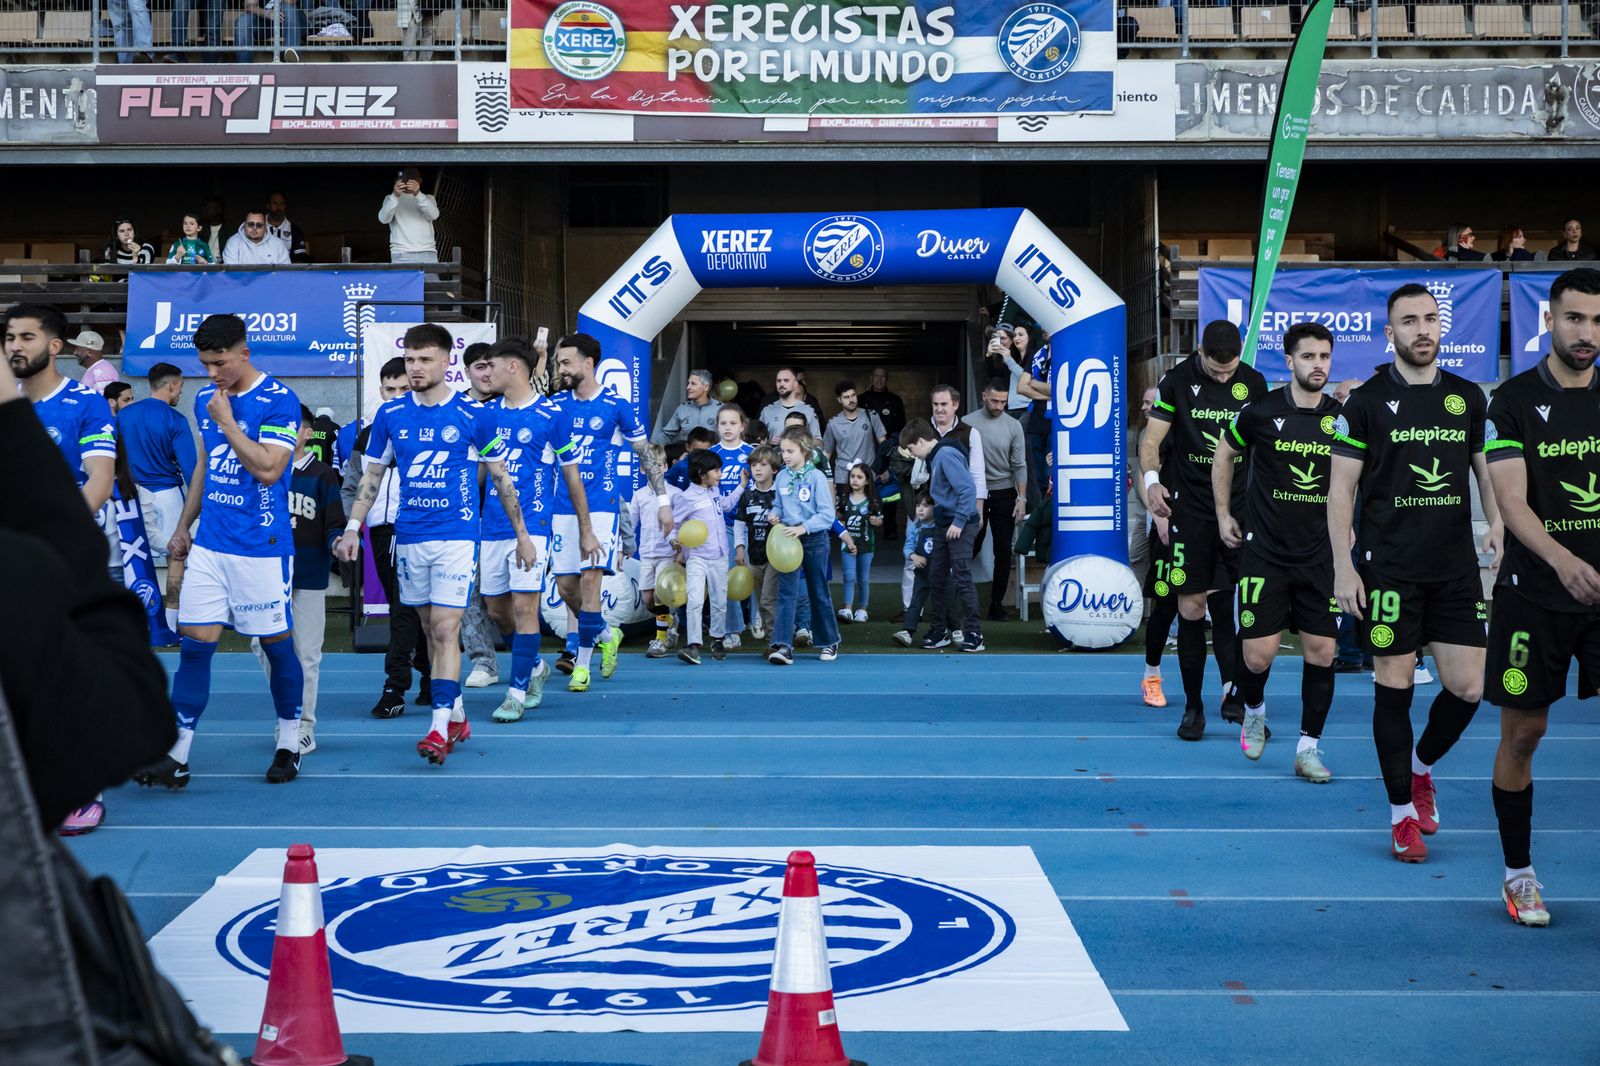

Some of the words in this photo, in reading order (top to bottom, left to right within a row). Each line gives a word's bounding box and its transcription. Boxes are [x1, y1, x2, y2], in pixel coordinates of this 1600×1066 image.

[668, 4, 954, 46] XERECISTAS
[558, 33, 613, 47] XEREZ
[668, 49, 748, 82] POR
[760, 49, 801, 83] EL
[810, 50, 955, 83] MUNDO
[1010, 60, 1069, 80] DEPORTIVO
[120, 87, 248, 117] PLAY
[542, 83, 579, 101] En
[627, 89, 728, 107] distancia
[740, 91, 801, 105] unidos
[809, 96, 859, 113] por
[1359, 84, 1399, 116] DE
[282, 120, 335, 129] EXPLORA,
[340, 120, 395, 129] DISFRUTA,
[400, 120, 448, 128] COMPITE.
[820, 119, 873, 128] EXPLORA,
[879, 119, 934, 128] DISFRUTA,
[939, 119, 988, 127] COMPITE.
[701, 229, 772, 253] XEREZ
[916, 229, 990, 258] Diver
[707, 253, 767, 270] DEPORTIVO
[329, 352, 345, 361] de
[1436, 358, 1463, 367] erez
[1390, 426, 1466, 446] telepizza
[1275, 439, 1331, 458] telepizz
[219, 459, 242, 475] Air
[423, 465, 449, 478] Air
[1394, 494, 1461, 507] Extremadura
[1173, 543, 1185, 567] 5
[1155, 559, 1171, 582] 11
[1057, 578, 1133, 612] Diver
[1240, 576, 1265, 604] 17
[1370, 589, 1400, 623] 19
[1509, 630, 1530, 668] 6
[444, 885, 774, 968] XEREZ
